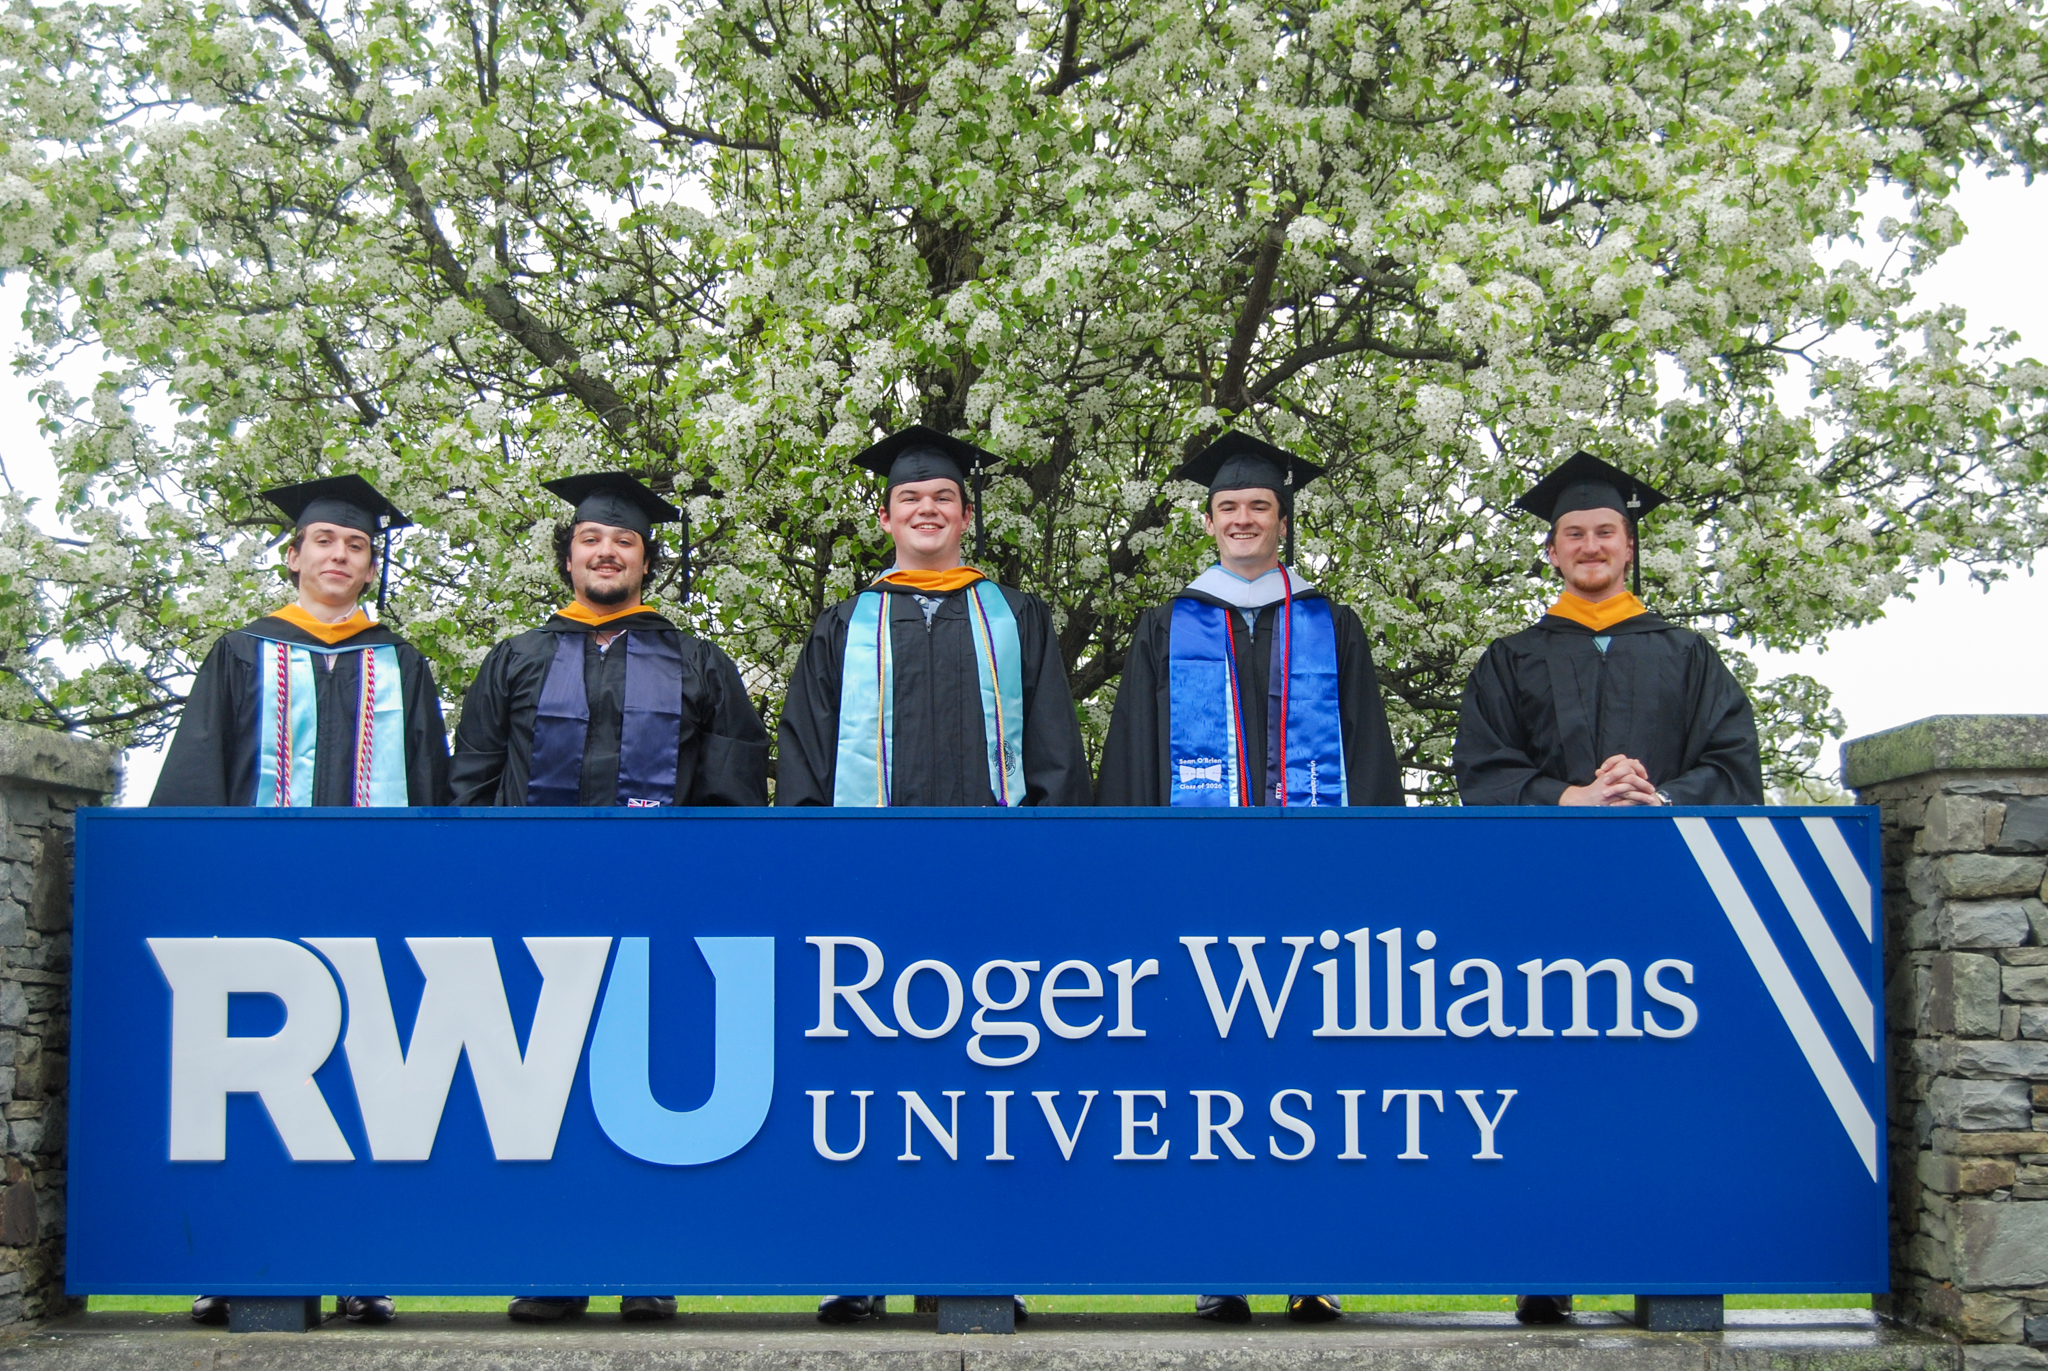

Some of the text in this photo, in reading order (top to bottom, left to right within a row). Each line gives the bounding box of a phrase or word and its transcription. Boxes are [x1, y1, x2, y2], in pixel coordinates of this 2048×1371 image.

[146, 936, 775, 1166] RWU
[805, 928, 1699, 1067] Roger Williams
[806, 1089, 1519, 1162] UNIVERSITY
